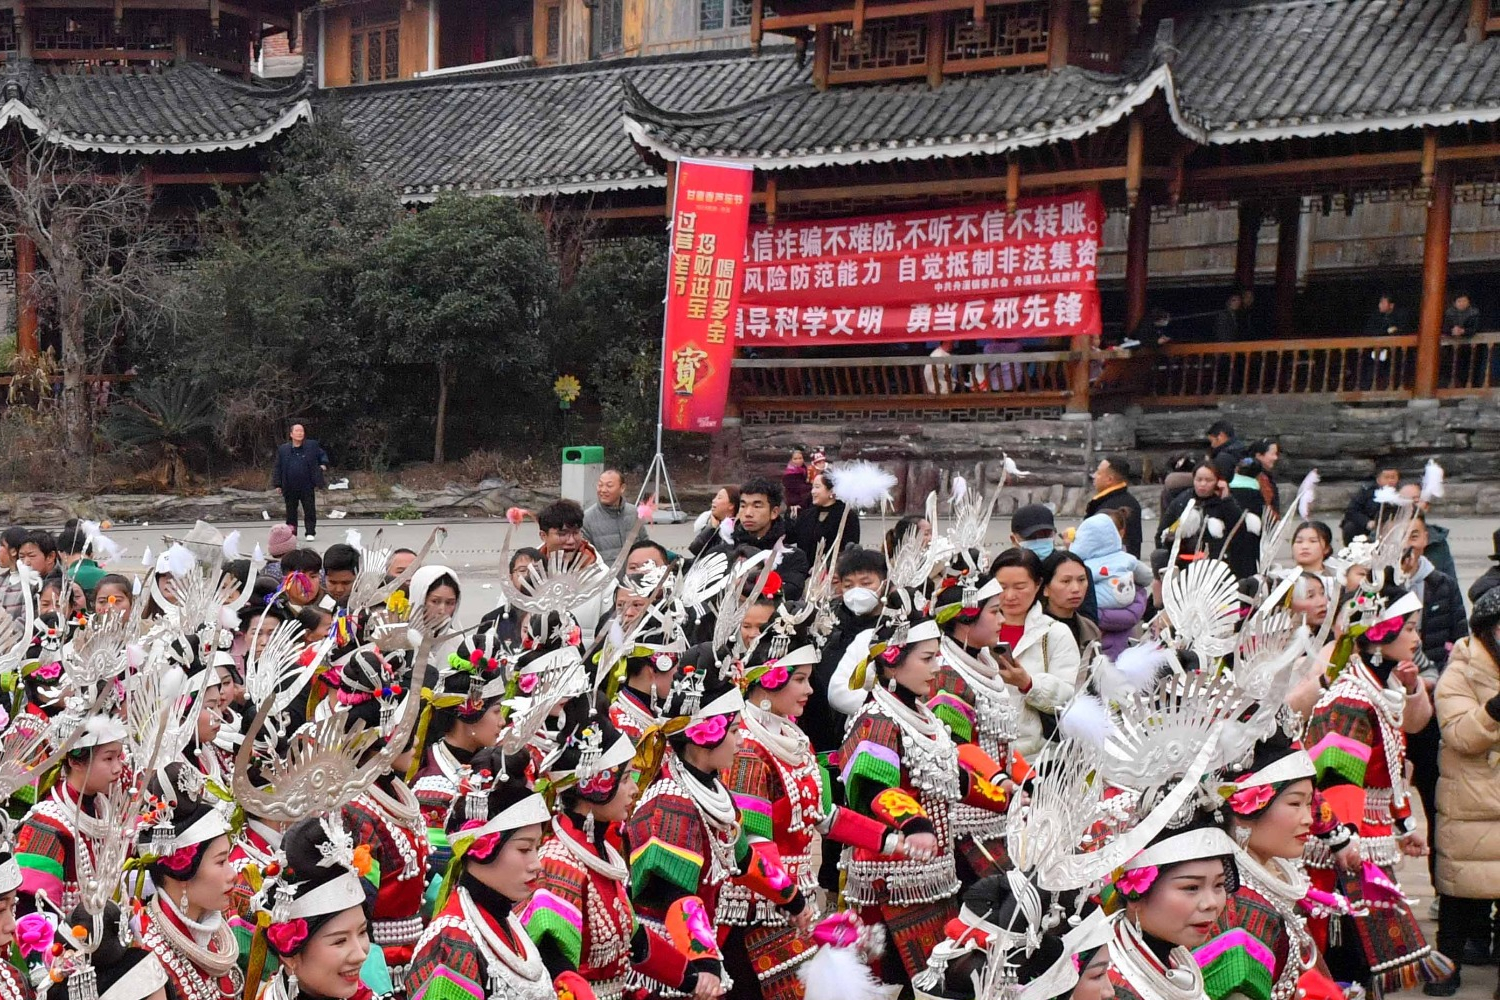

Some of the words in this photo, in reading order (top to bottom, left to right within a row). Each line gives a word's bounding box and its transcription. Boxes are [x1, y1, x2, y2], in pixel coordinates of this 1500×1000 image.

[675, 211, 697, 296] 过芦笙节
[743, 201, 1097, 263] 信诈骗不难防，不听不信不转账。
[744, 257, 882, 294] 风险防范能力
[899, 238, 1098, 283] 自觉抵制非法集资
[687, 233, 716, 319] 招财进宝
[707, 258, 735, 344] 喝加多宝
[906, 291, 1083, 334] 勇当反邪先锋
